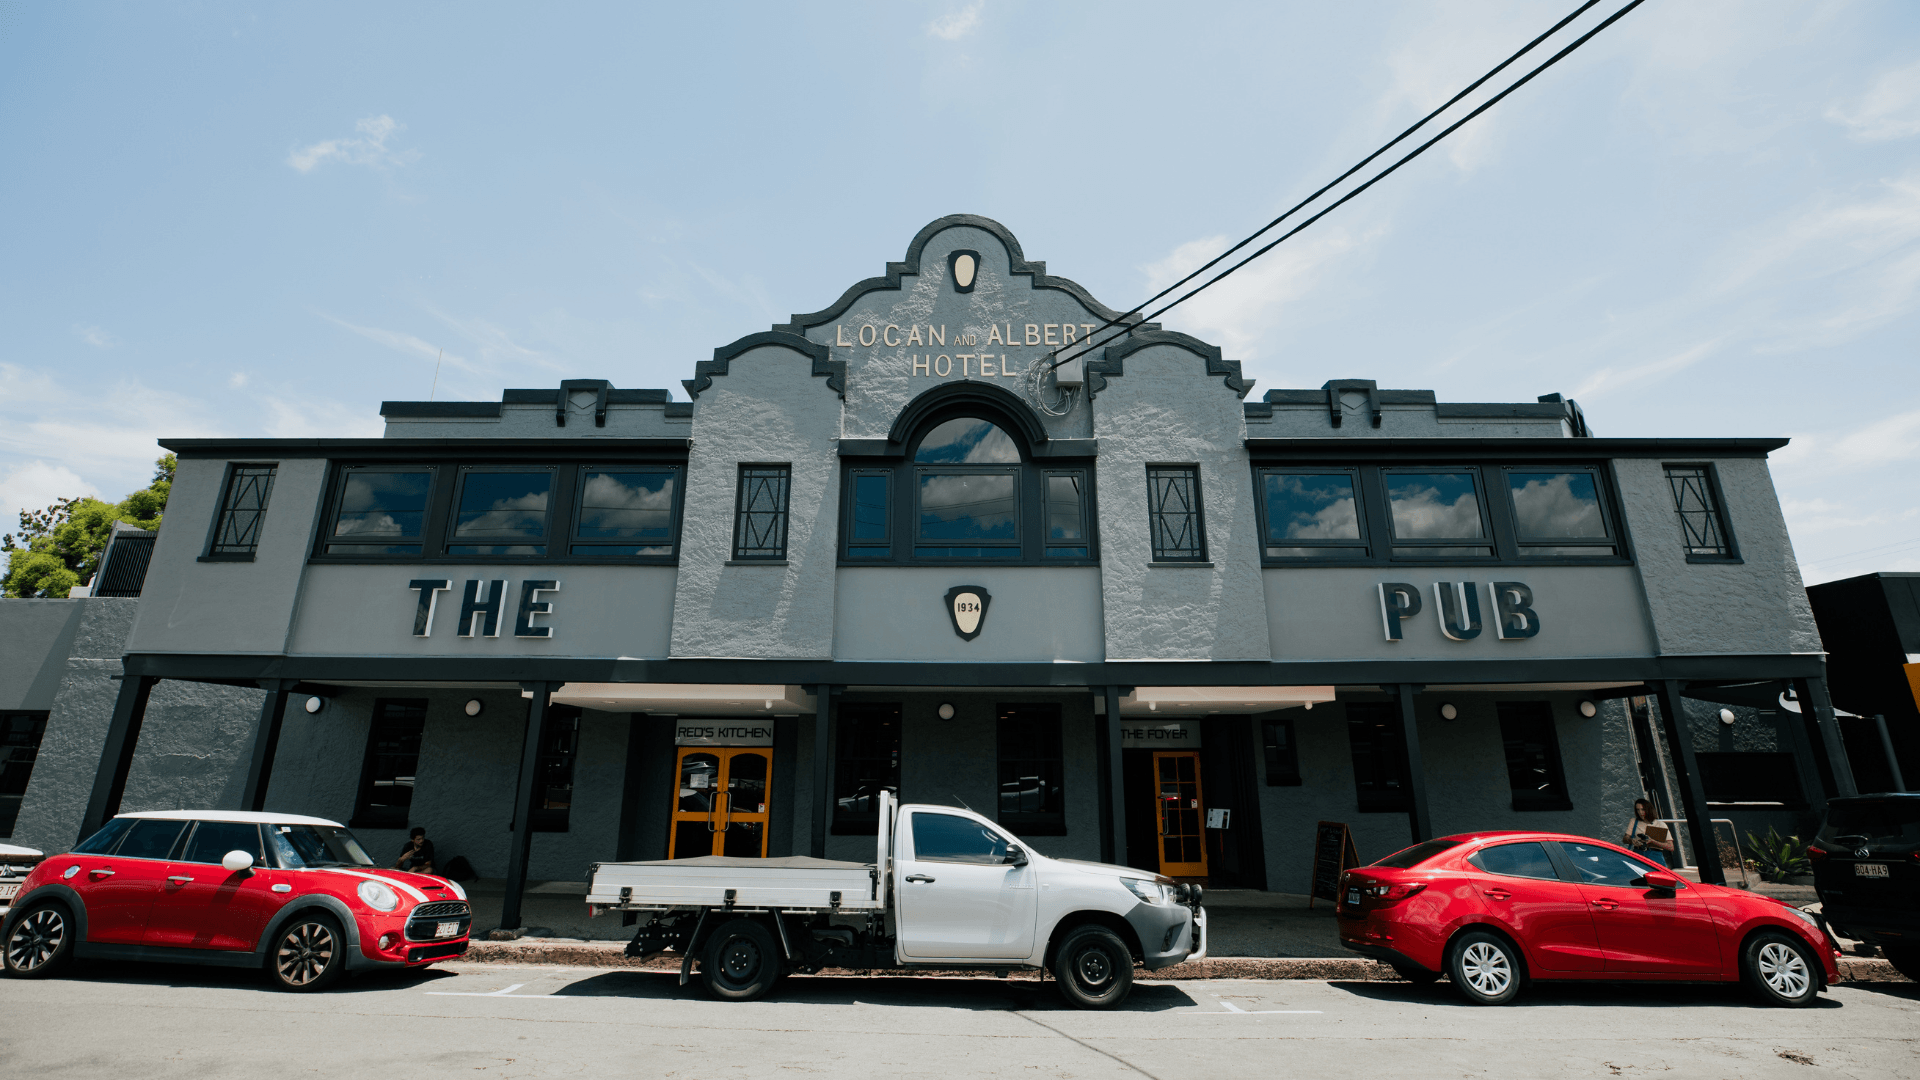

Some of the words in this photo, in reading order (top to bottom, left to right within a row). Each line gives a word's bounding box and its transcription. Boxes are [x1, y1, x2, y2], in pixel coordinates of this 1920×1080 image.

[836, 324, 946, 347] LOGAN
[953, 335, 976, 346] AND
[987, 323, 1096, 346] ALBERT
[912, 354, 1017, 377] HOTEL
[409, 579, 561, 639] THE
[957, 602, 980, 613] 1934
[1377, 581, 1540, 641] PUB
[678, 727, 714, 738] RED'S
[718, 727, 772, 738] KITCHEN
[1121, 729, 1144, 739] THE
[1148, 729, 1188, 739] FOYER
